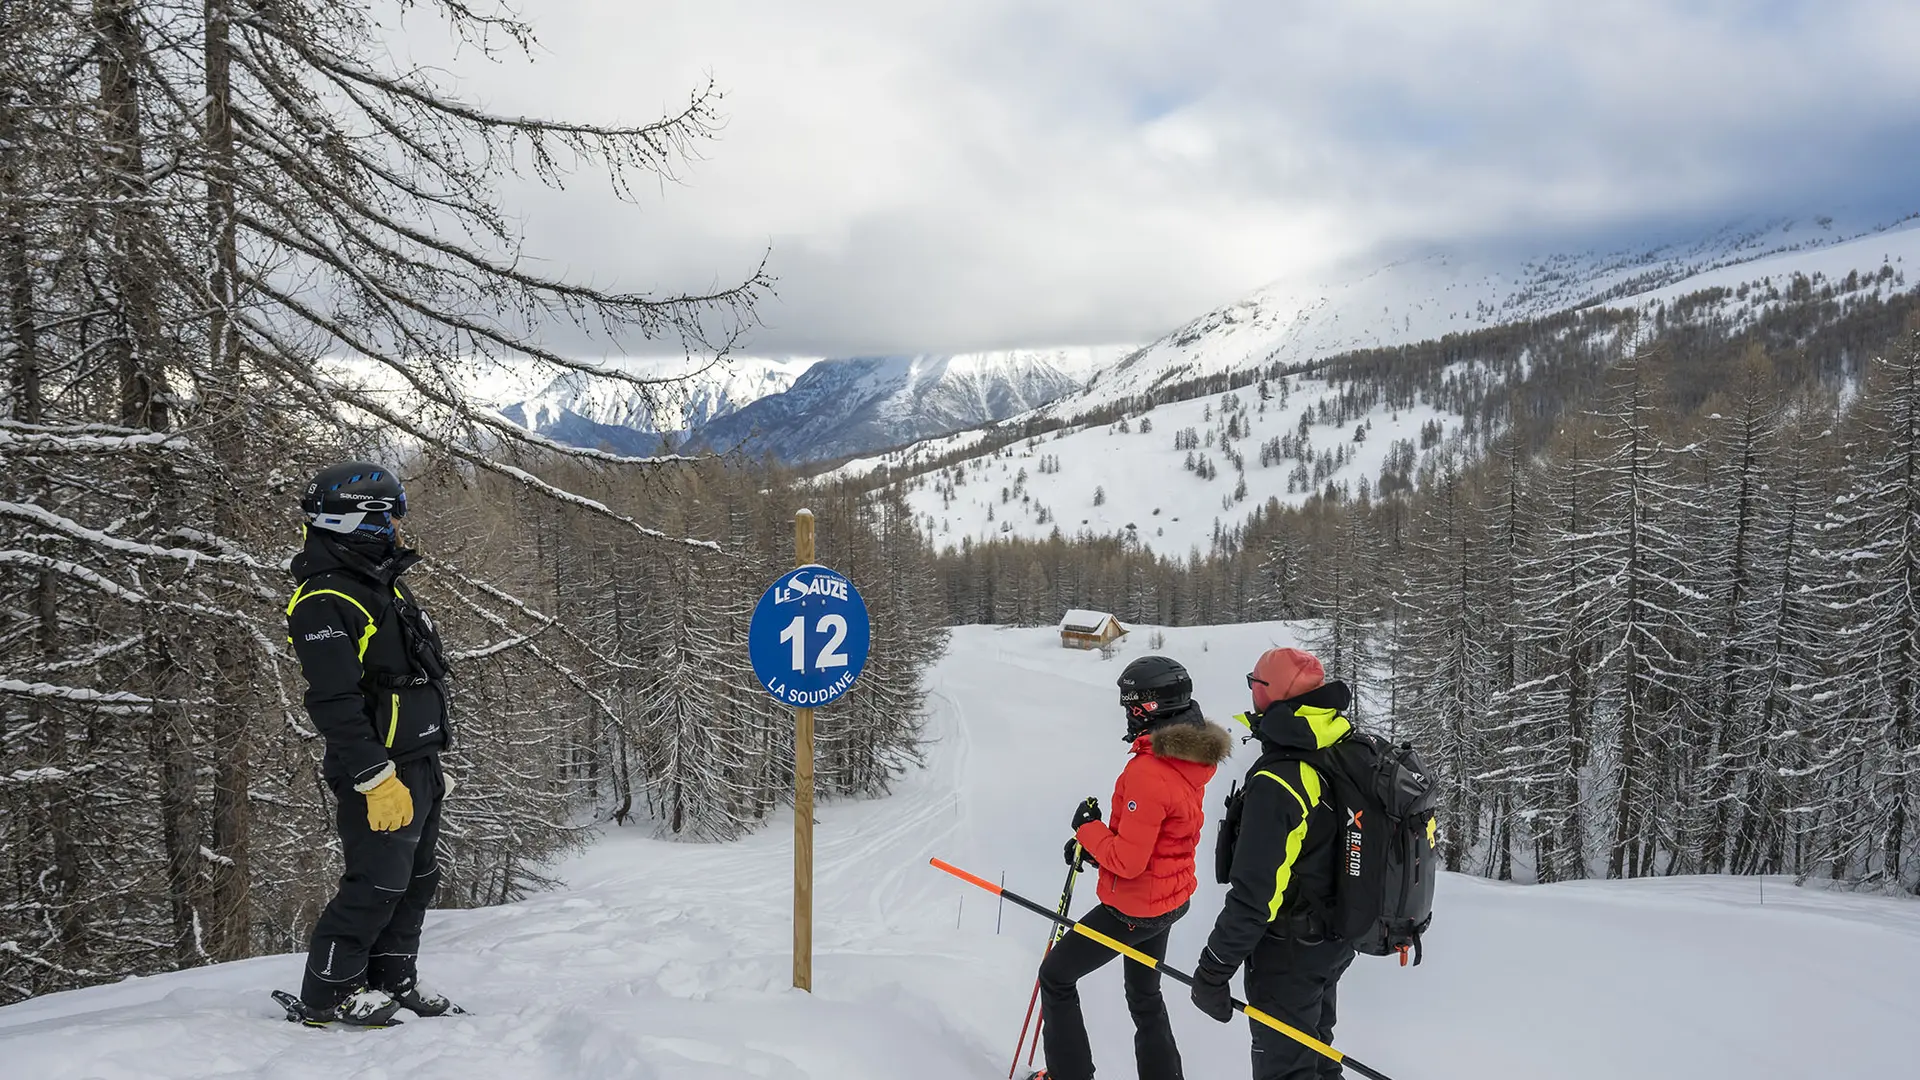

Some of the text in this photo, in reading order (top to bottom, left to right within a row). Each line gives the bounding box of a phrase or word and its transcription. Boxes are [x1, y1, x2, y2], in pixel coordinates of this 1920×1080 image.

[774, 571, 848, 605] LE SAUZE
[305, 632, 330, 642] Ubaye
[780, 614, 848, 671] 12
[767, 670, 855, 704] LA SOUDANE
[1350, 831, 1361, 876] REACTOR
